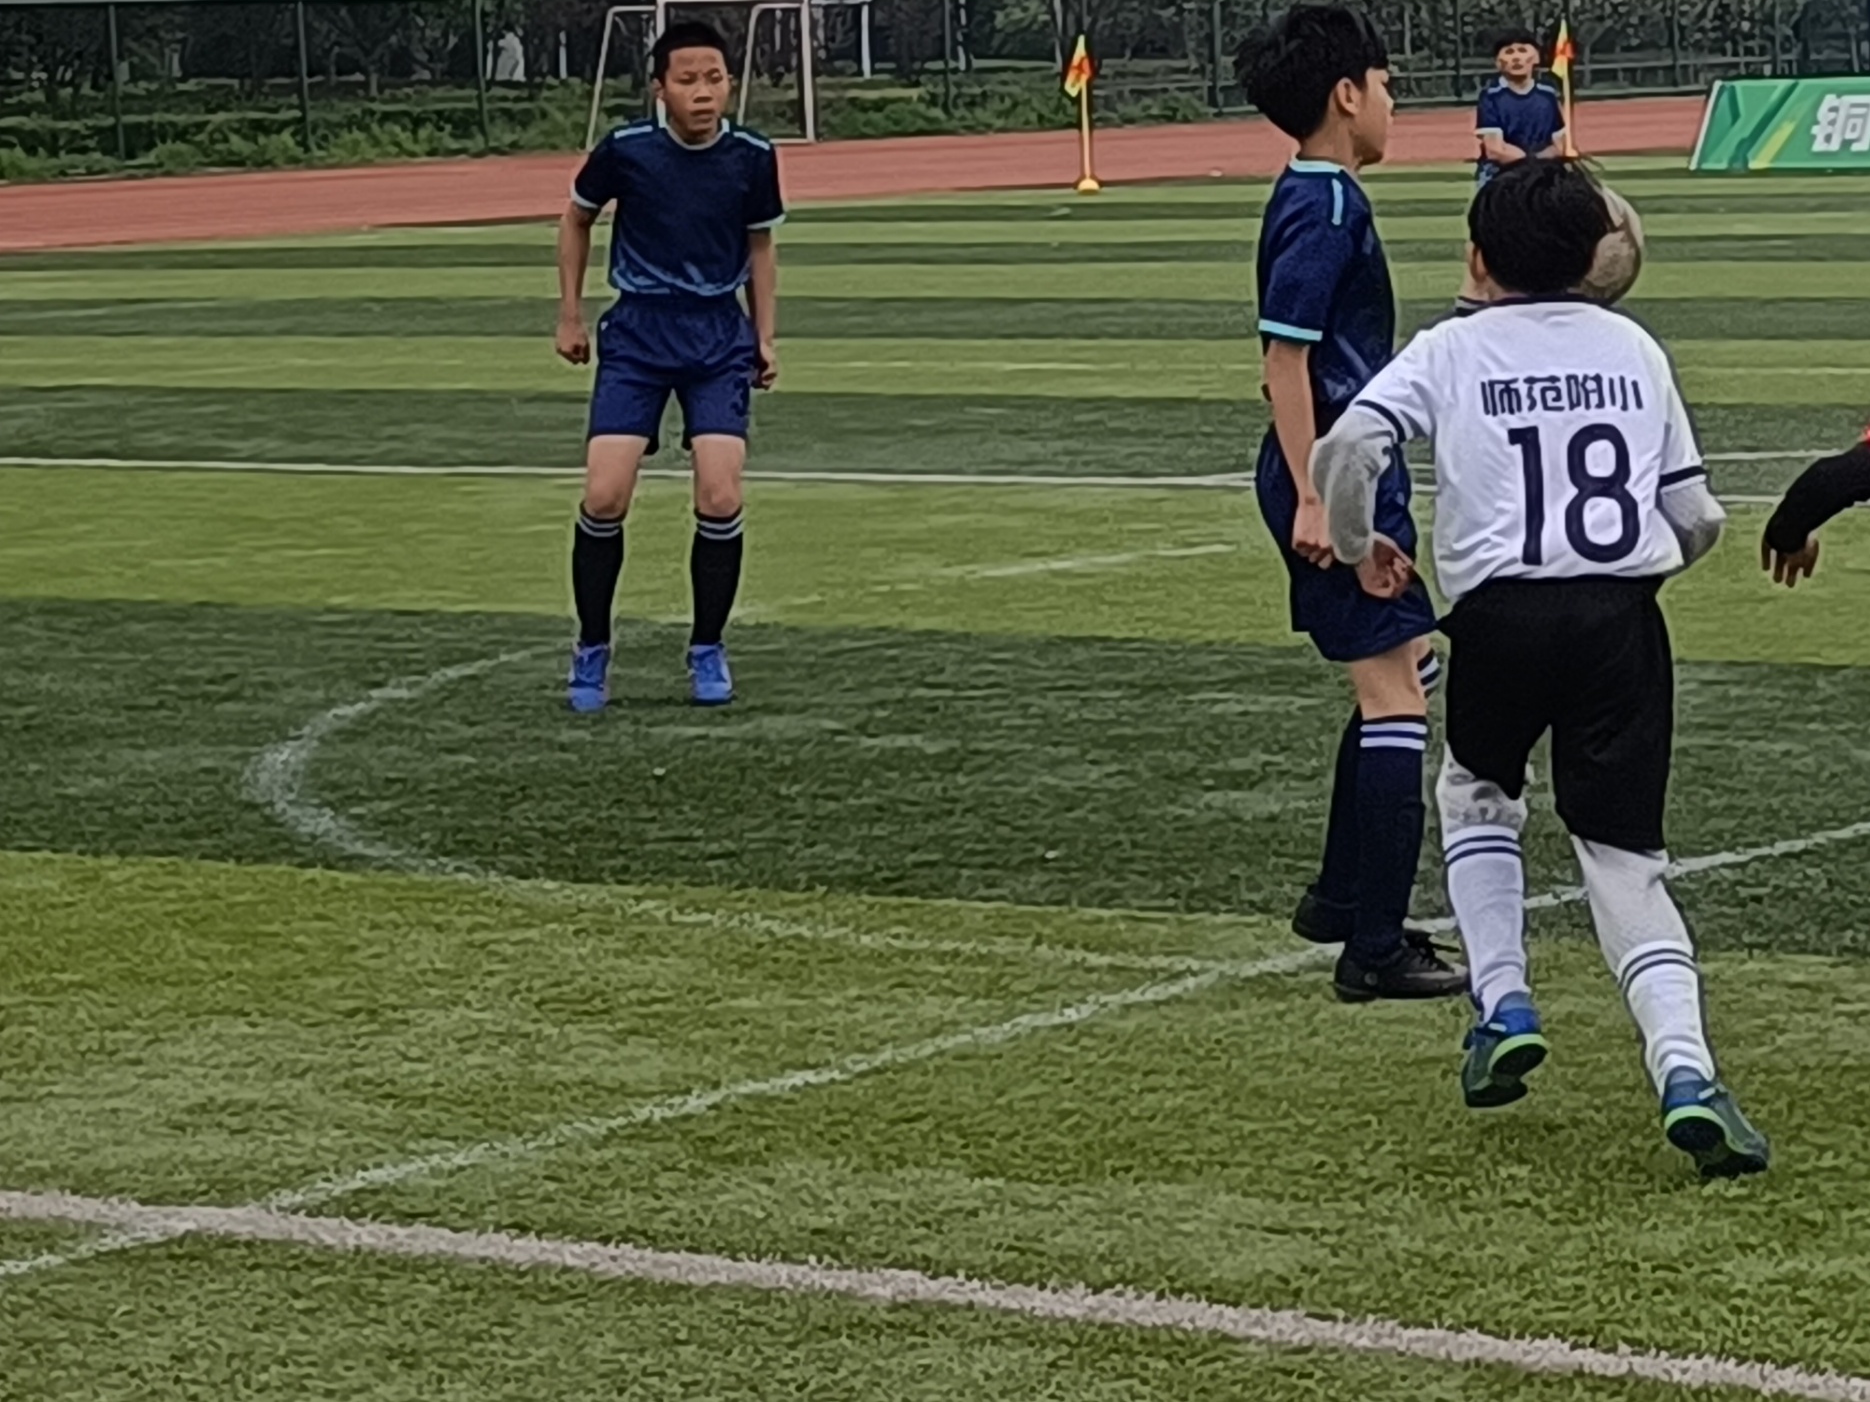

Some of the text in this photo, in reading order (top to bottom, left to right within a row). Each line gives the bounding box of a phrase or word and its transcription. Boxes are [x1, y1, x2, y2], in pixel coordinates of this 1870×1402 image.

[1480, 373, 1643, 416] 师范附小
[1508, 423, 1641, 566] 18
